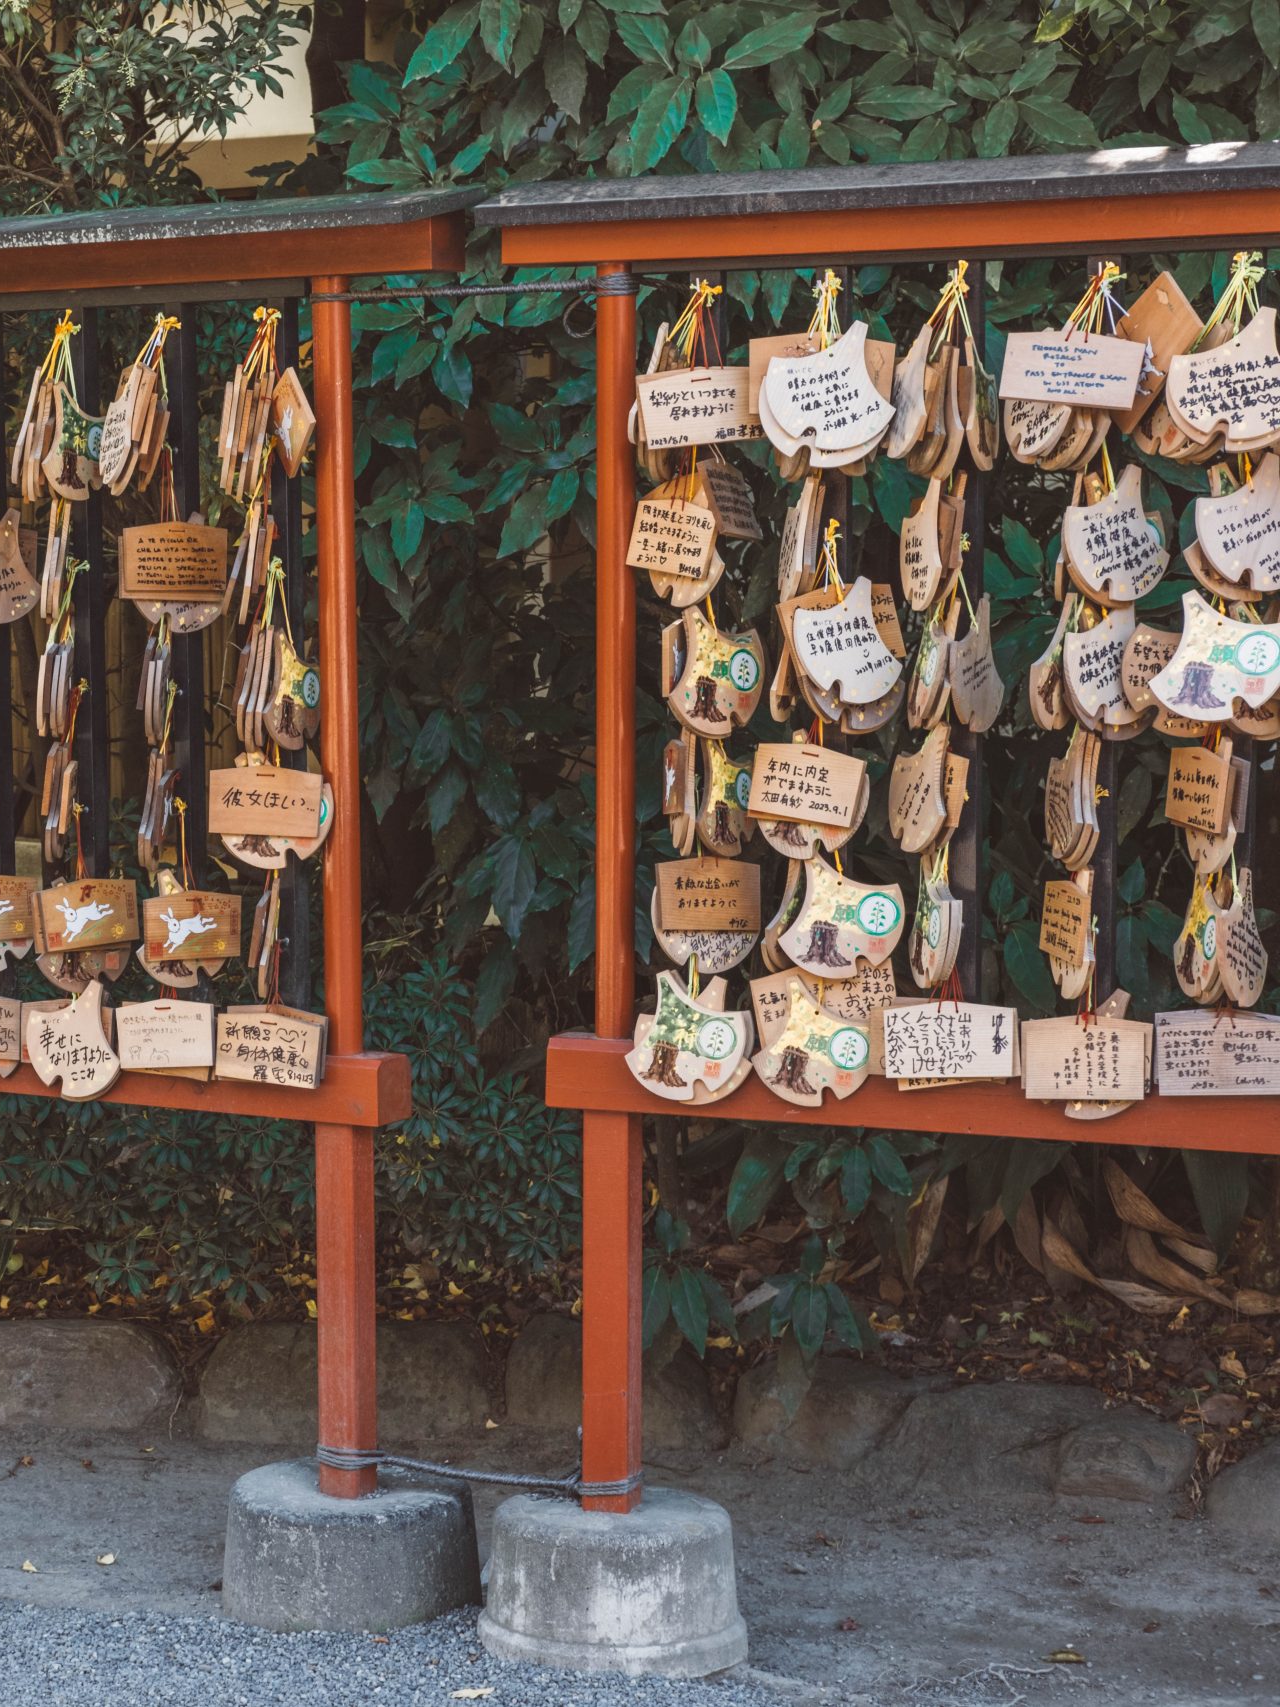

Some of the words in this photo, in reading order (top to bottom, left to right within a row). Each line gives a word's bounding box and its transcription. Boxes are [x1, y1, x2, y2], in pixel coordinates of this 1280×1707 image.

[768, 757, 829, 783] 年内に内定
[674, 876, 740, 890] 素敵な出会いが
[678, 898, 737, 909] ありますように
[40, 1025, 82, 1055] 幸せに
[49, 1046, 112, 1066] なりますように
[236, 1045, 298, 1069] 身体健康
